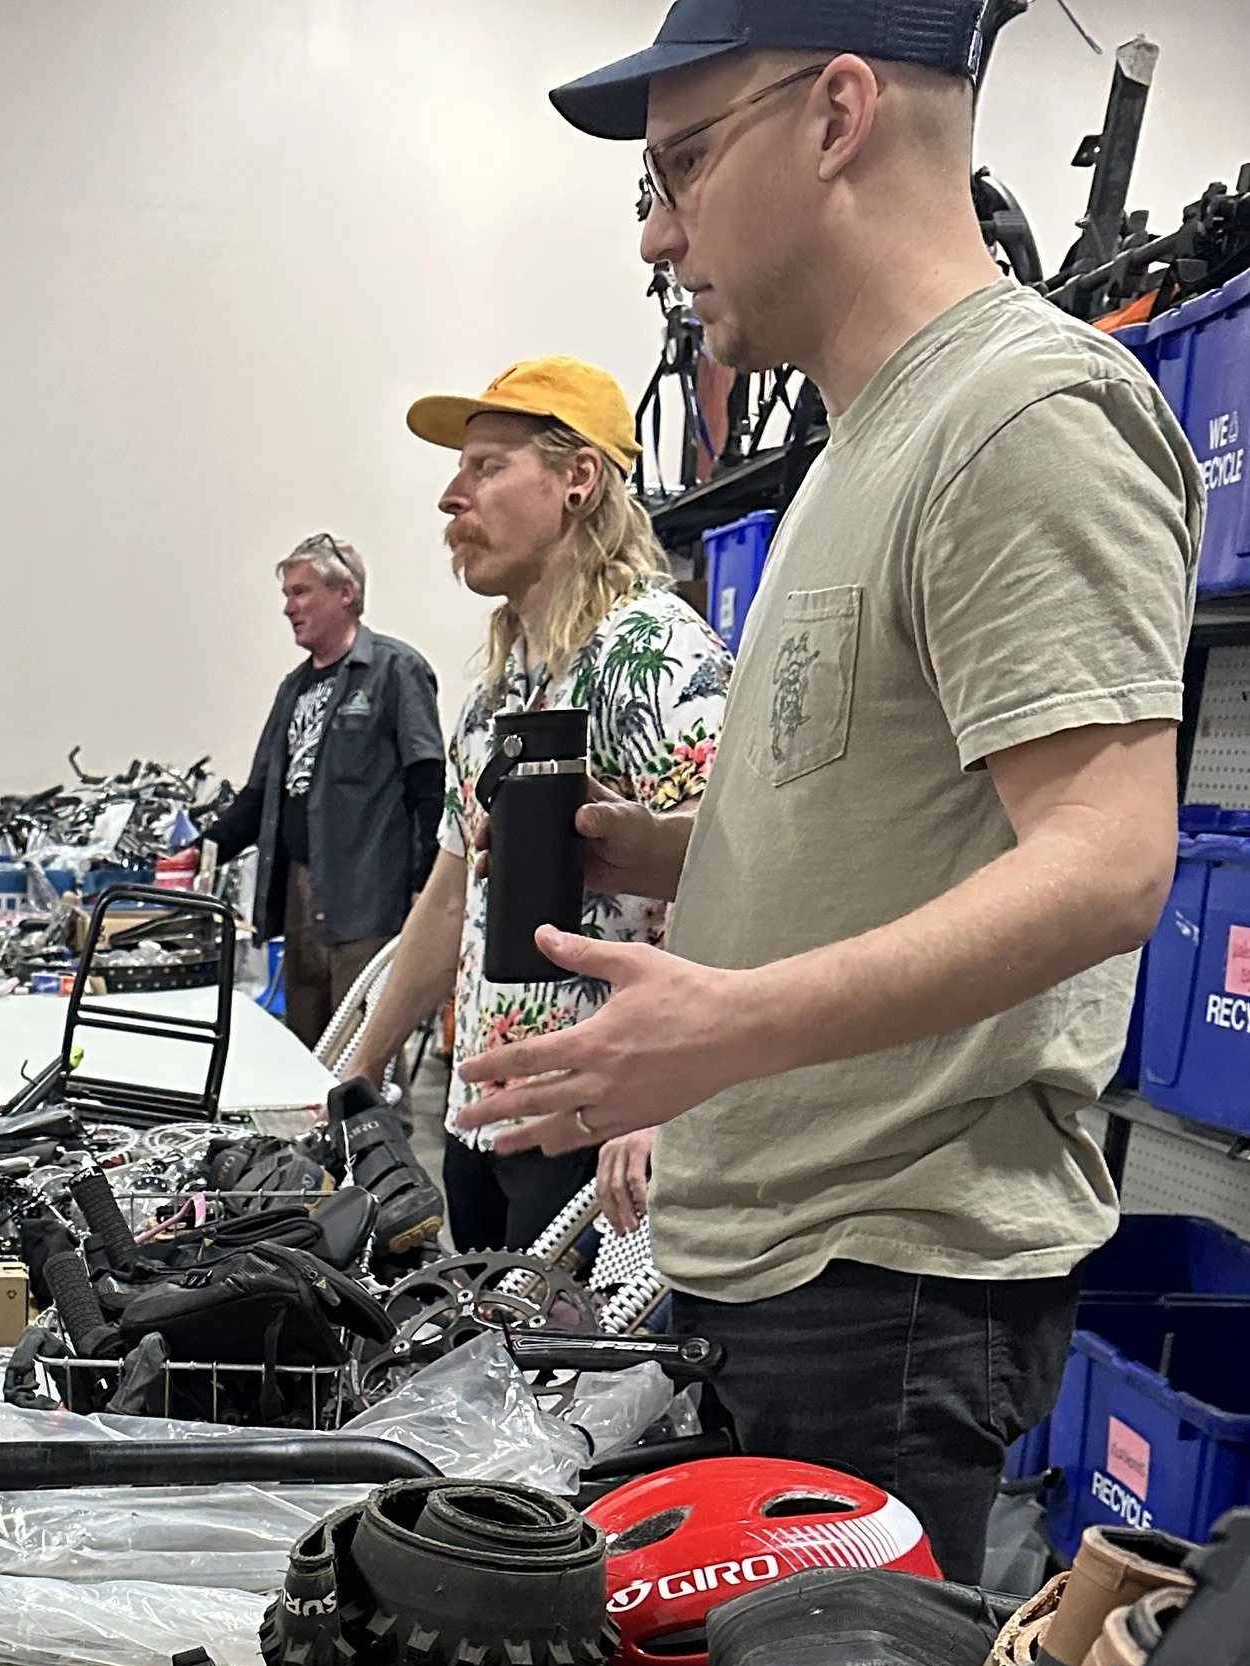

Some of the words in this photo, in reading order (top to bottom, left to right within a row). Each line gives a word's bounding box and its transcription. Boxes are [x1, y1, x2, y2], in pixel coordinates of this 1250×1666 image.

[1209, 413, 1230, 450] WE
[1092, 1471, 1153, 1531] RECYCLE
[657, 1554, 779, 1600] GIRO
[285, 1590, 337, 1617] SUR
